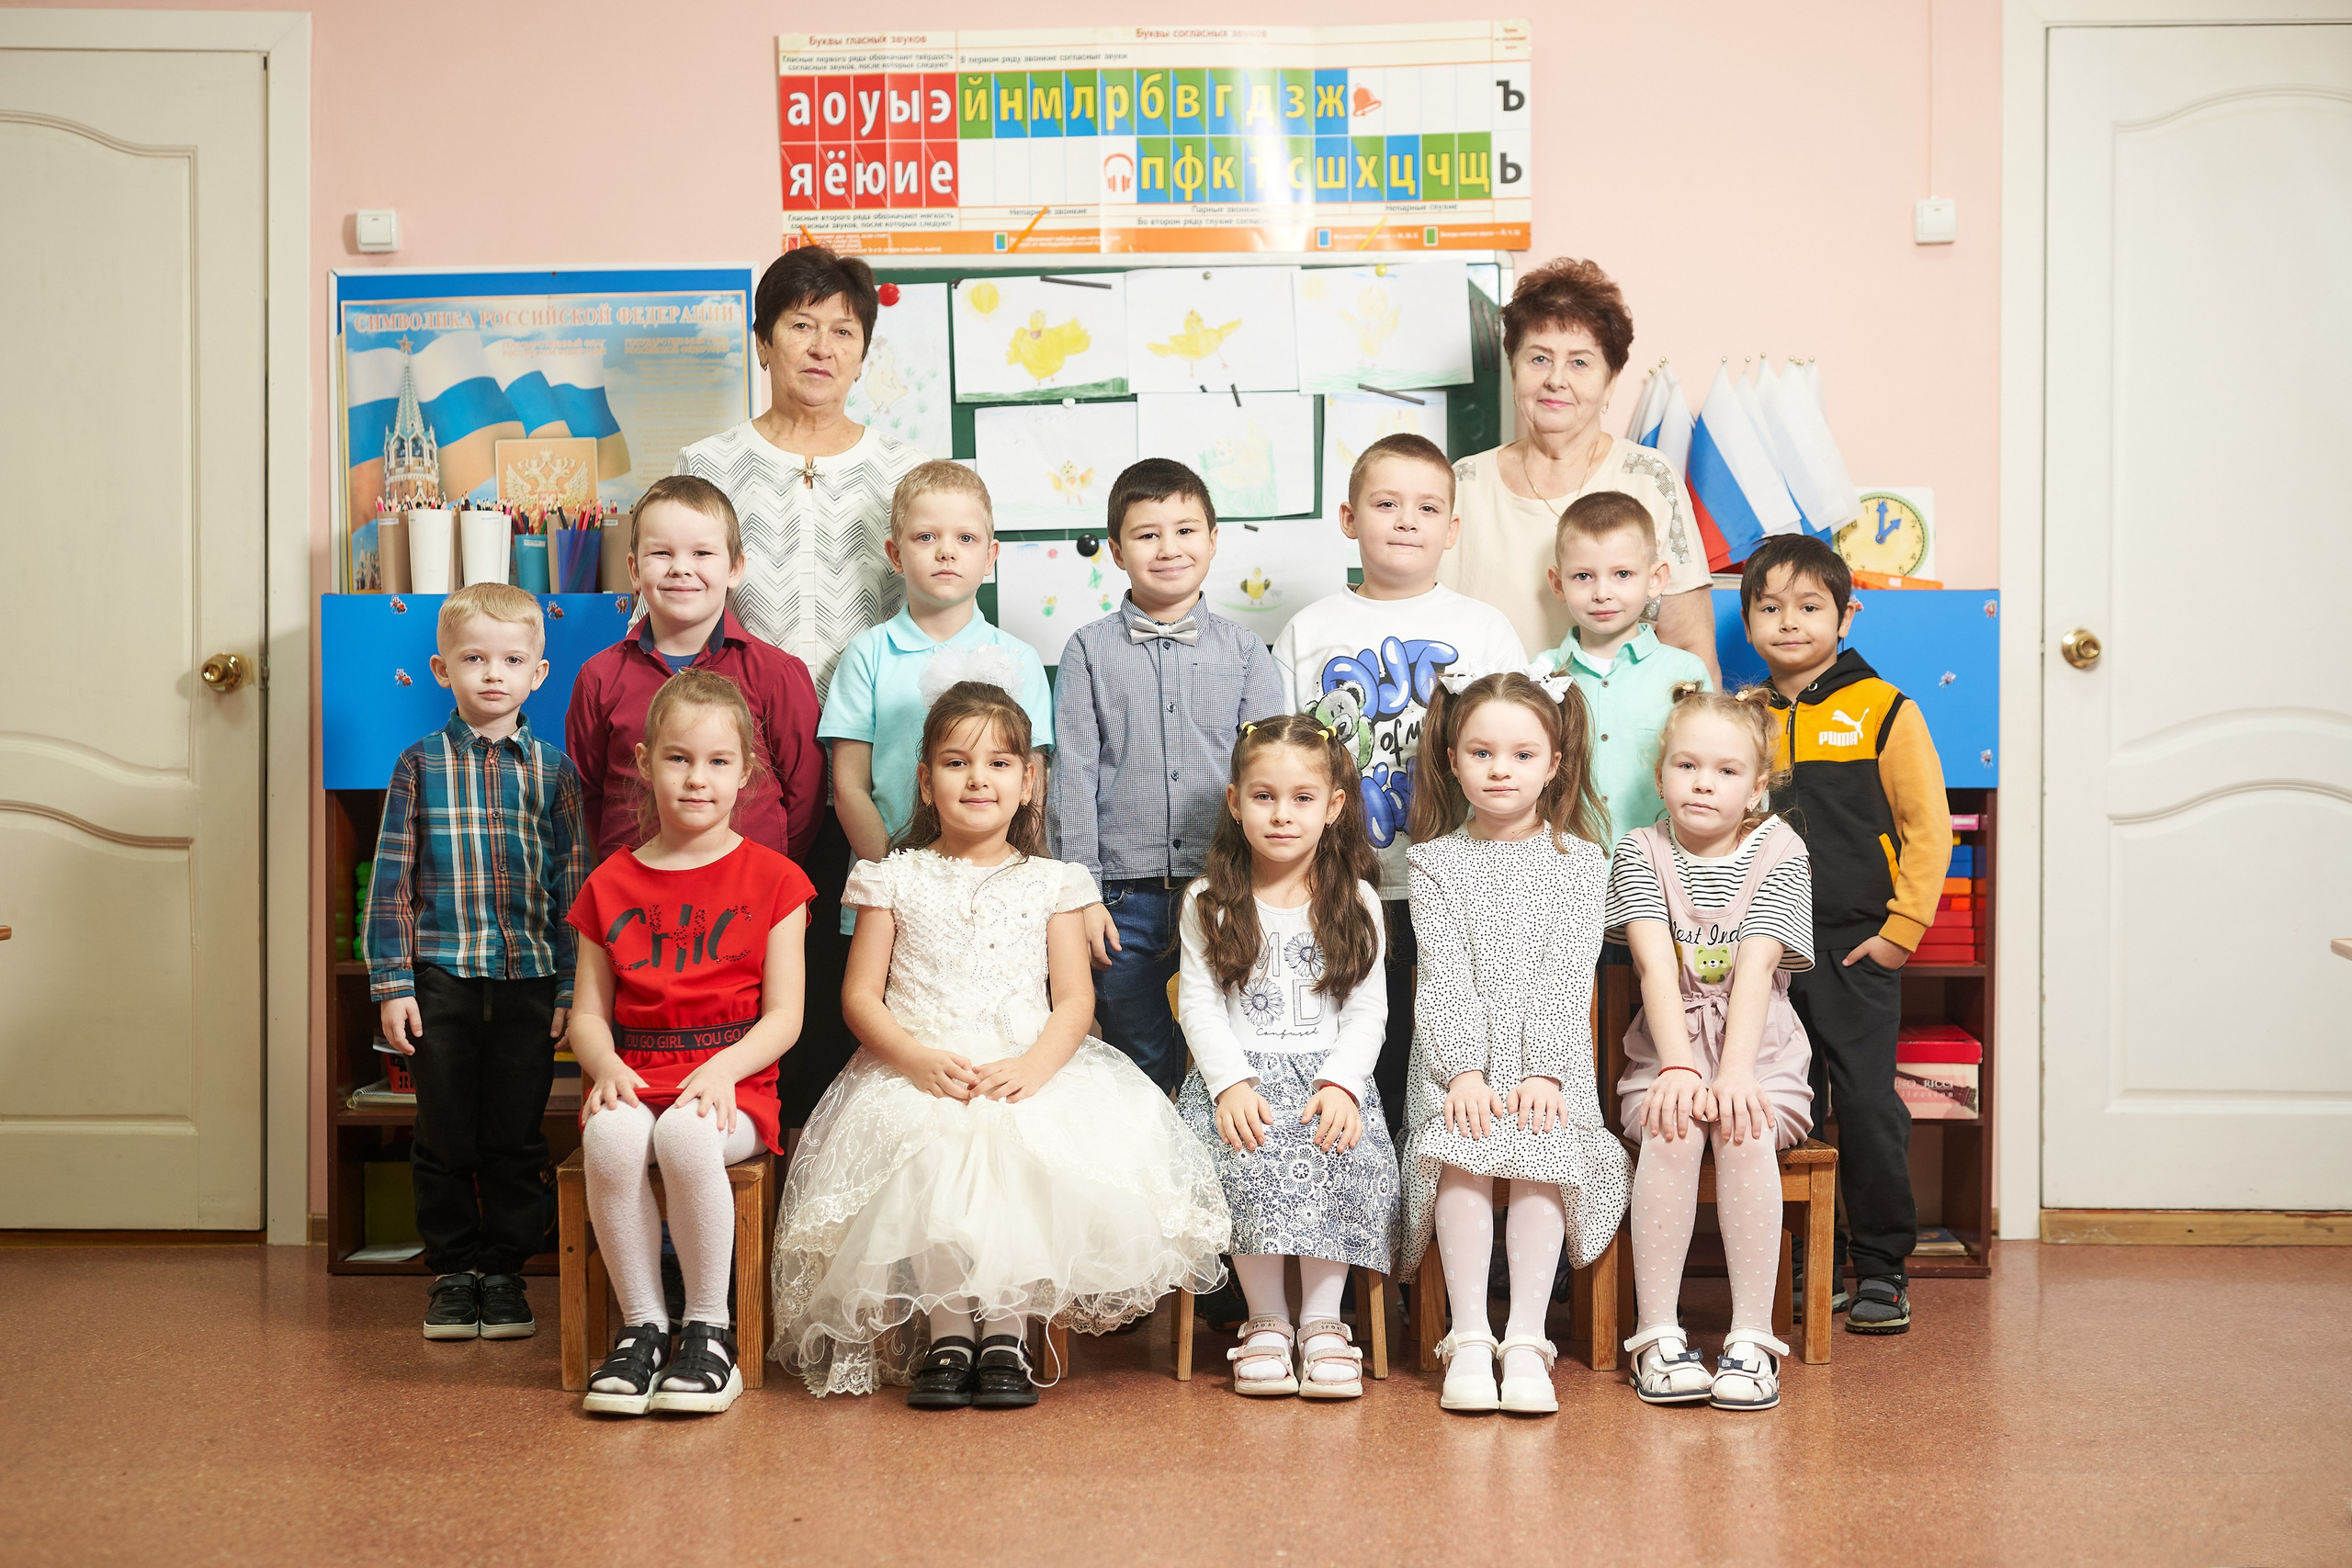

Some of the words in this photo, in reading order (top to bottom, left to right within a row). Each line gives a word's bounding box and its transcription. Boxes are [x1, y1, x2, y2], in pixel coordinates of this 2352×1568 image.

[808, 36, 842, 47] Буквы
[845, 35, 888, 45] гласных
[891, 35, 927, 46] звуков
[1136, 28, 1170, 39] Буквы
[1172, 28, 1228, 39] согласных
[787, 91, 811, 127] а
[888, 89, 921, 124] ы
[929, 88, 952, 124] э
[963, 76, 988, 121] й
[999, 87, 1023, 121] н
[1031, 85, 1063, 120] м
[1069, 85, 1094, 119] л
[1105, 85, 1130, 130] р
[1139, 73, 1165, 119] б
[1175, 85, 1201, 118] в
[1215, 85, 1233, 118] г
[1246, 85, 1274, 127] д
[788, 163, 812, 197] я
[823, 150, 847, 196] ё
[855, 161, 887, 196] ю
[894, 160, 919, 195] и
[929, 159, 954, 194] е
[1140, 156, 1165, 190] п
[1172, 144, 1204, 202] ф
[1389, 154, 1416, 197] ц
[1427, 152, 1451, 186] ч
[1458, 152, 1490, 193] щ
[354, 311, 475, 333] СИМВОЛИКА
[479, 304, 613, 329] РОССИЙСКОЙ
[616, 304, 734, 329] ФЕДЕРАЦИИ
[1380, 718, 1404, 767] of
[1818, 731, 1858, 747] PUMA
[605, 904, 752, 973] CHIC
[640, 1034, 655, 1048] GO
[657, 1035, 685, 1049] GIRL
[694, 1032, 721, 1047] YOU
[724, 1028, 741, 1043] GO
[1255, 1027, 1319, 1040] Confused
